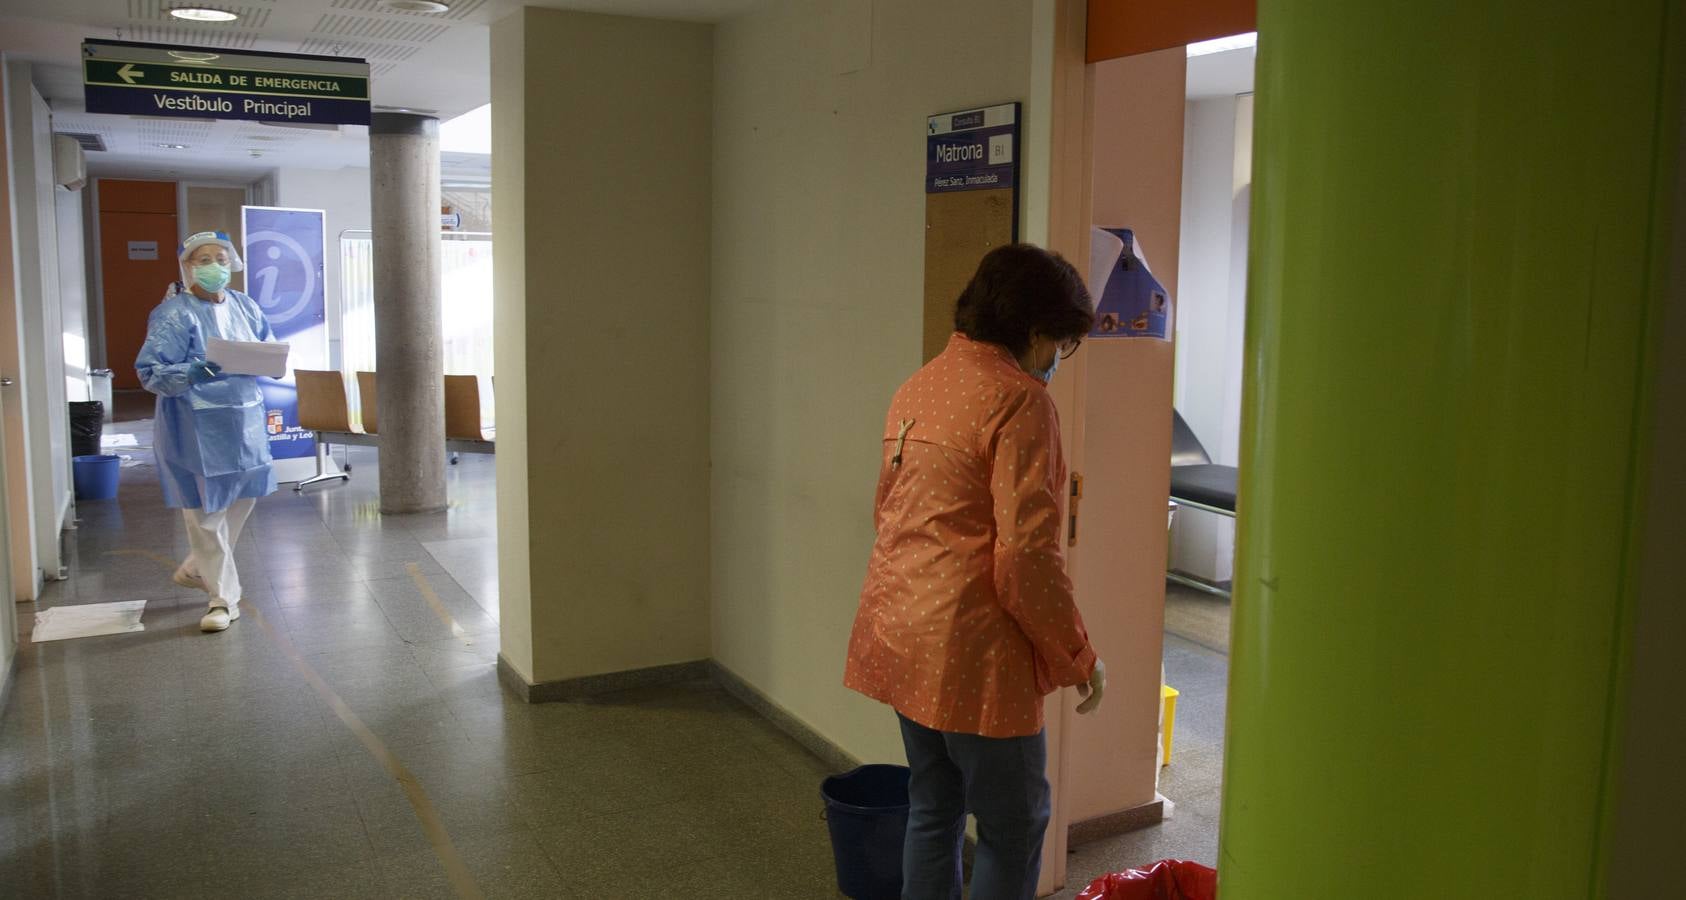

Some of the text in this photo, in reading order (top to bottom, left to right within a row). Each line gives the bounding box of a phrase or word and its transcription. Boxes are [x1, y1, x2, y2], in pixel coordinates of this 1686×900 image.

[170, 71, 340, 92] SALIDA DE EMERGENCIA
[154, 94, 312, 117] Vestíbulo Principal
[936, 143, 983, 163] Matrona
